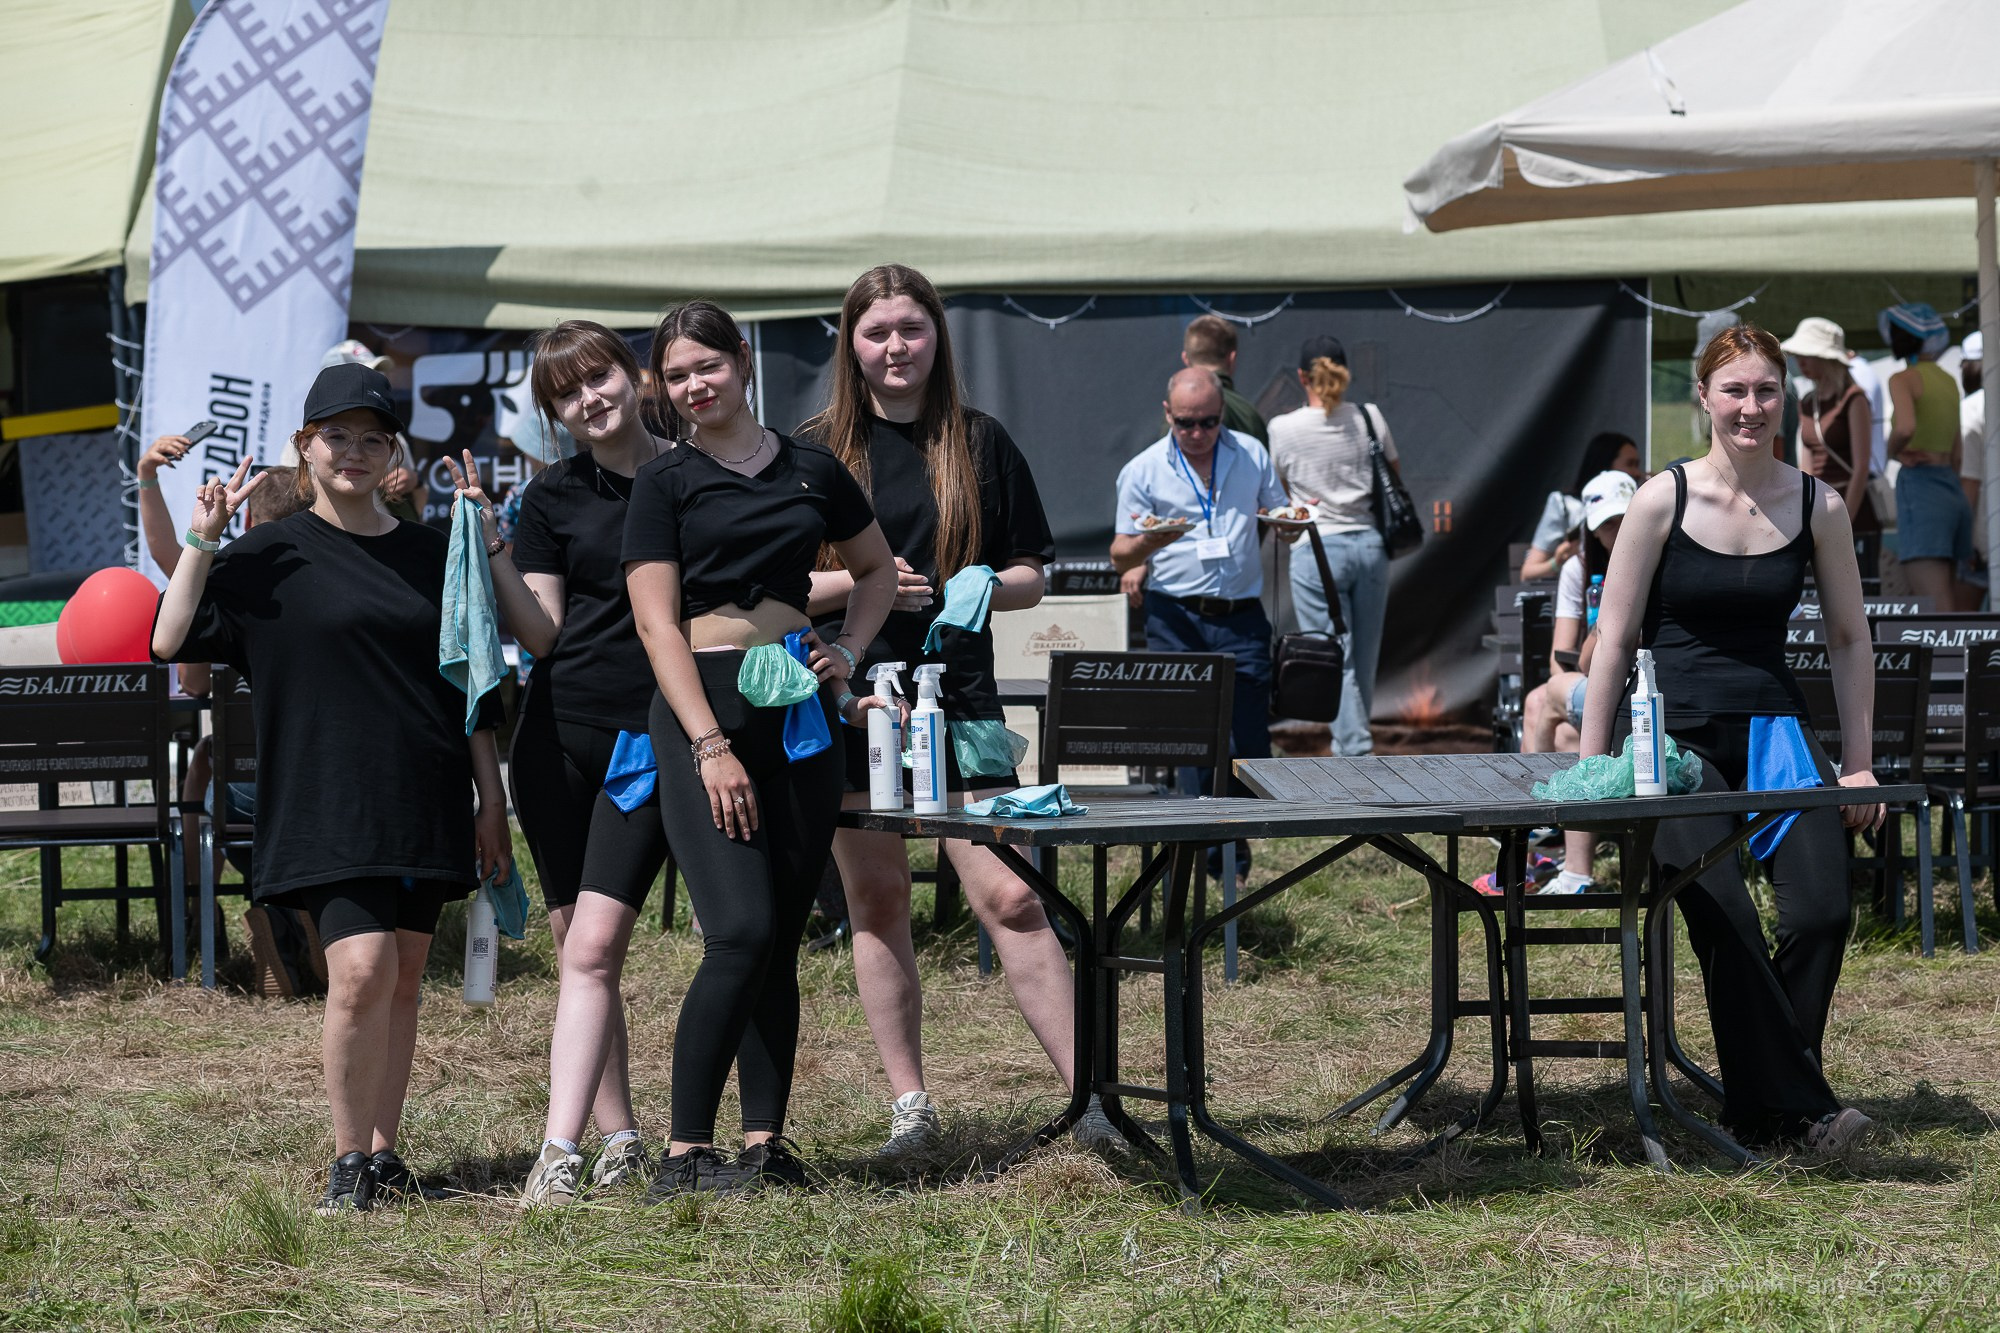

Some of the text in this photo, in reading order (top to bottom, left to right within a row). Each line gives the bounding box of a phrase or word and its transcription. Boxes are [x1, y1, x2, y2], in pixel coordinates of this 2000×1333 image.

[1922, 629, 1999, 647] БАЛТИ
[1794, 652, 1911, 670] БАКА
[1095, 663, 1214, 682] БАЛТИКА
[22, 673, 148, 695] БАЛТИКА
